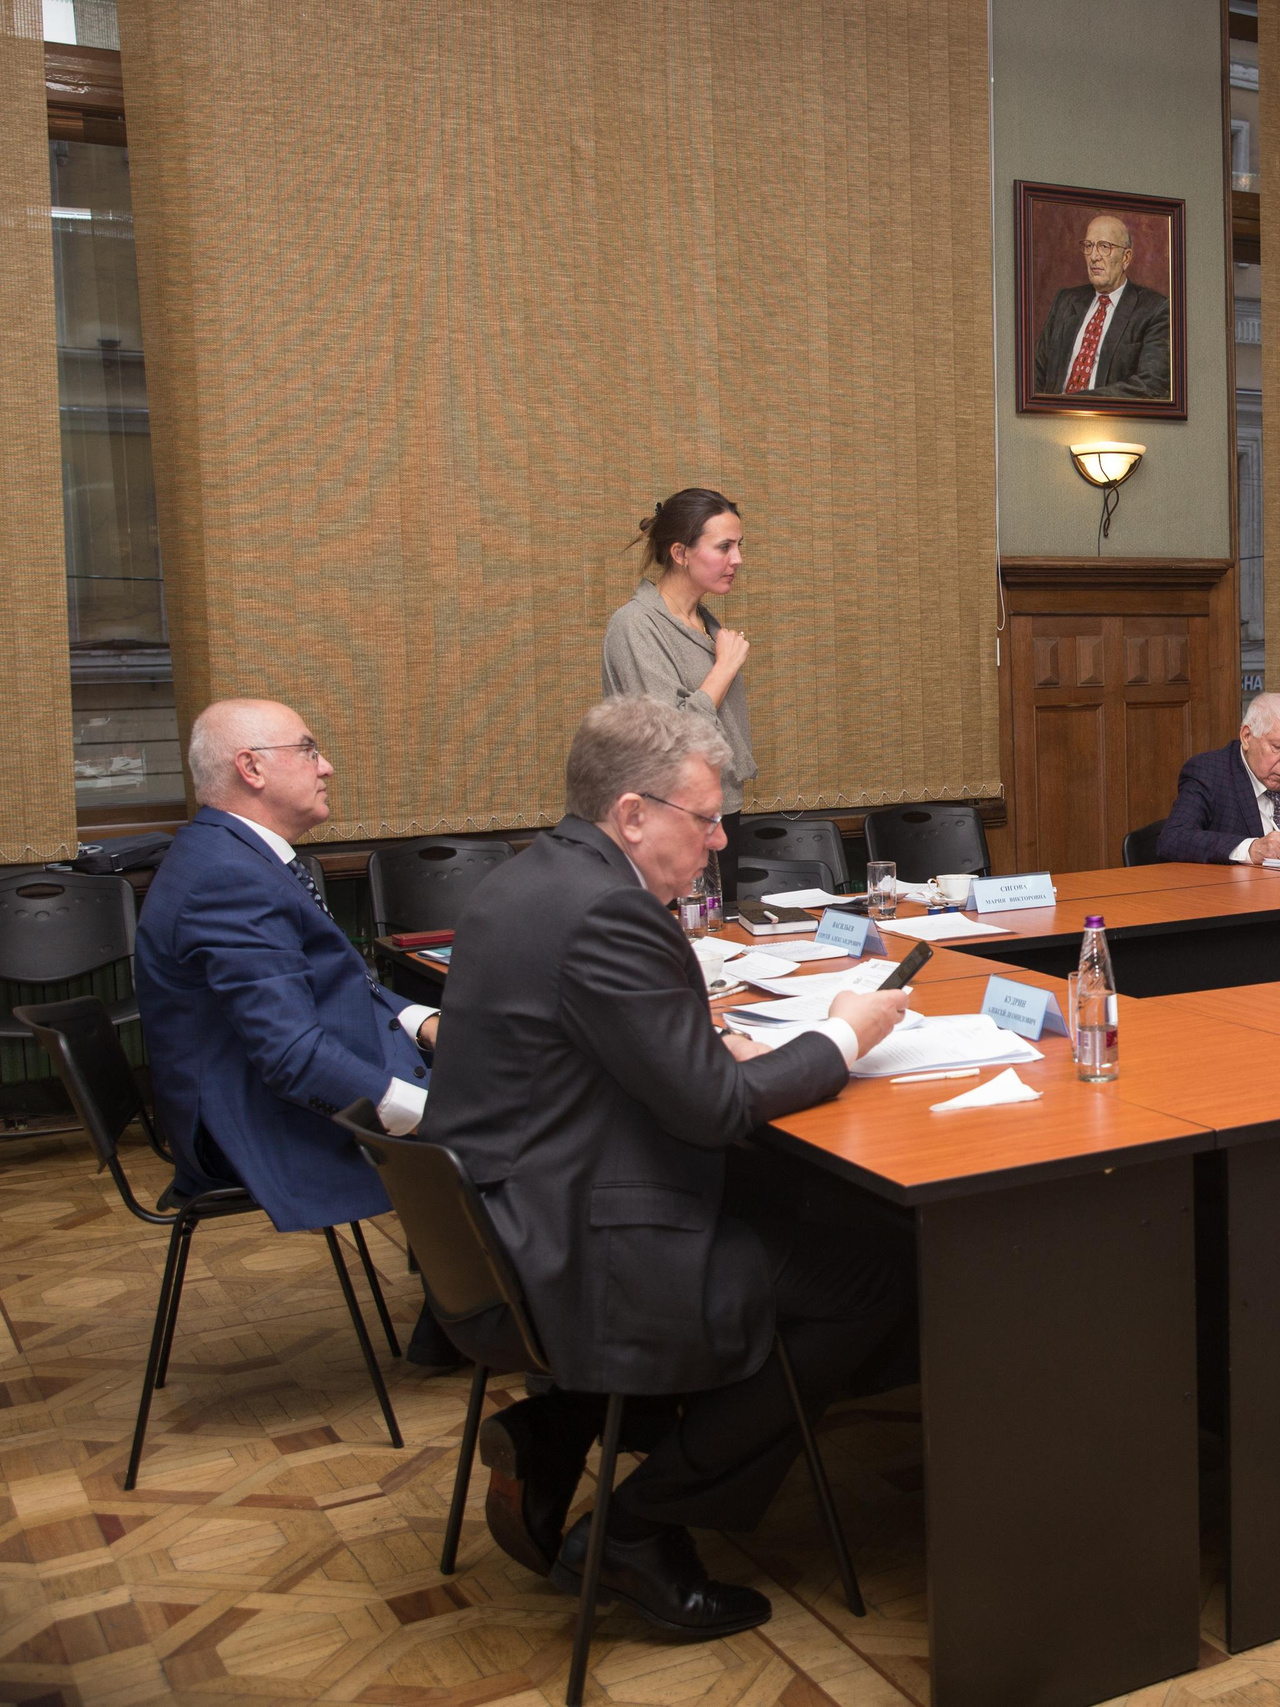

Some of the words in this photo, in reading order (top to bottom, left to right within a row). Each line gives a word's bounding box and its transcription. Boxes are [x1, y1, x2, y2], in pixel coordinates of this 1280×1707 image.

[1000, 884, 1027, 892] СИГОВА
[1009, 894, 1047, 902] ВИКТОРОВНА
[1004, 995, 1027, 1008] КУДРИН
[988, 1006, 1006, 1017] АЛЕКСЕЙ
[1006, 1011, 1037, 1026] ЛЕОНИДОВИЧ
